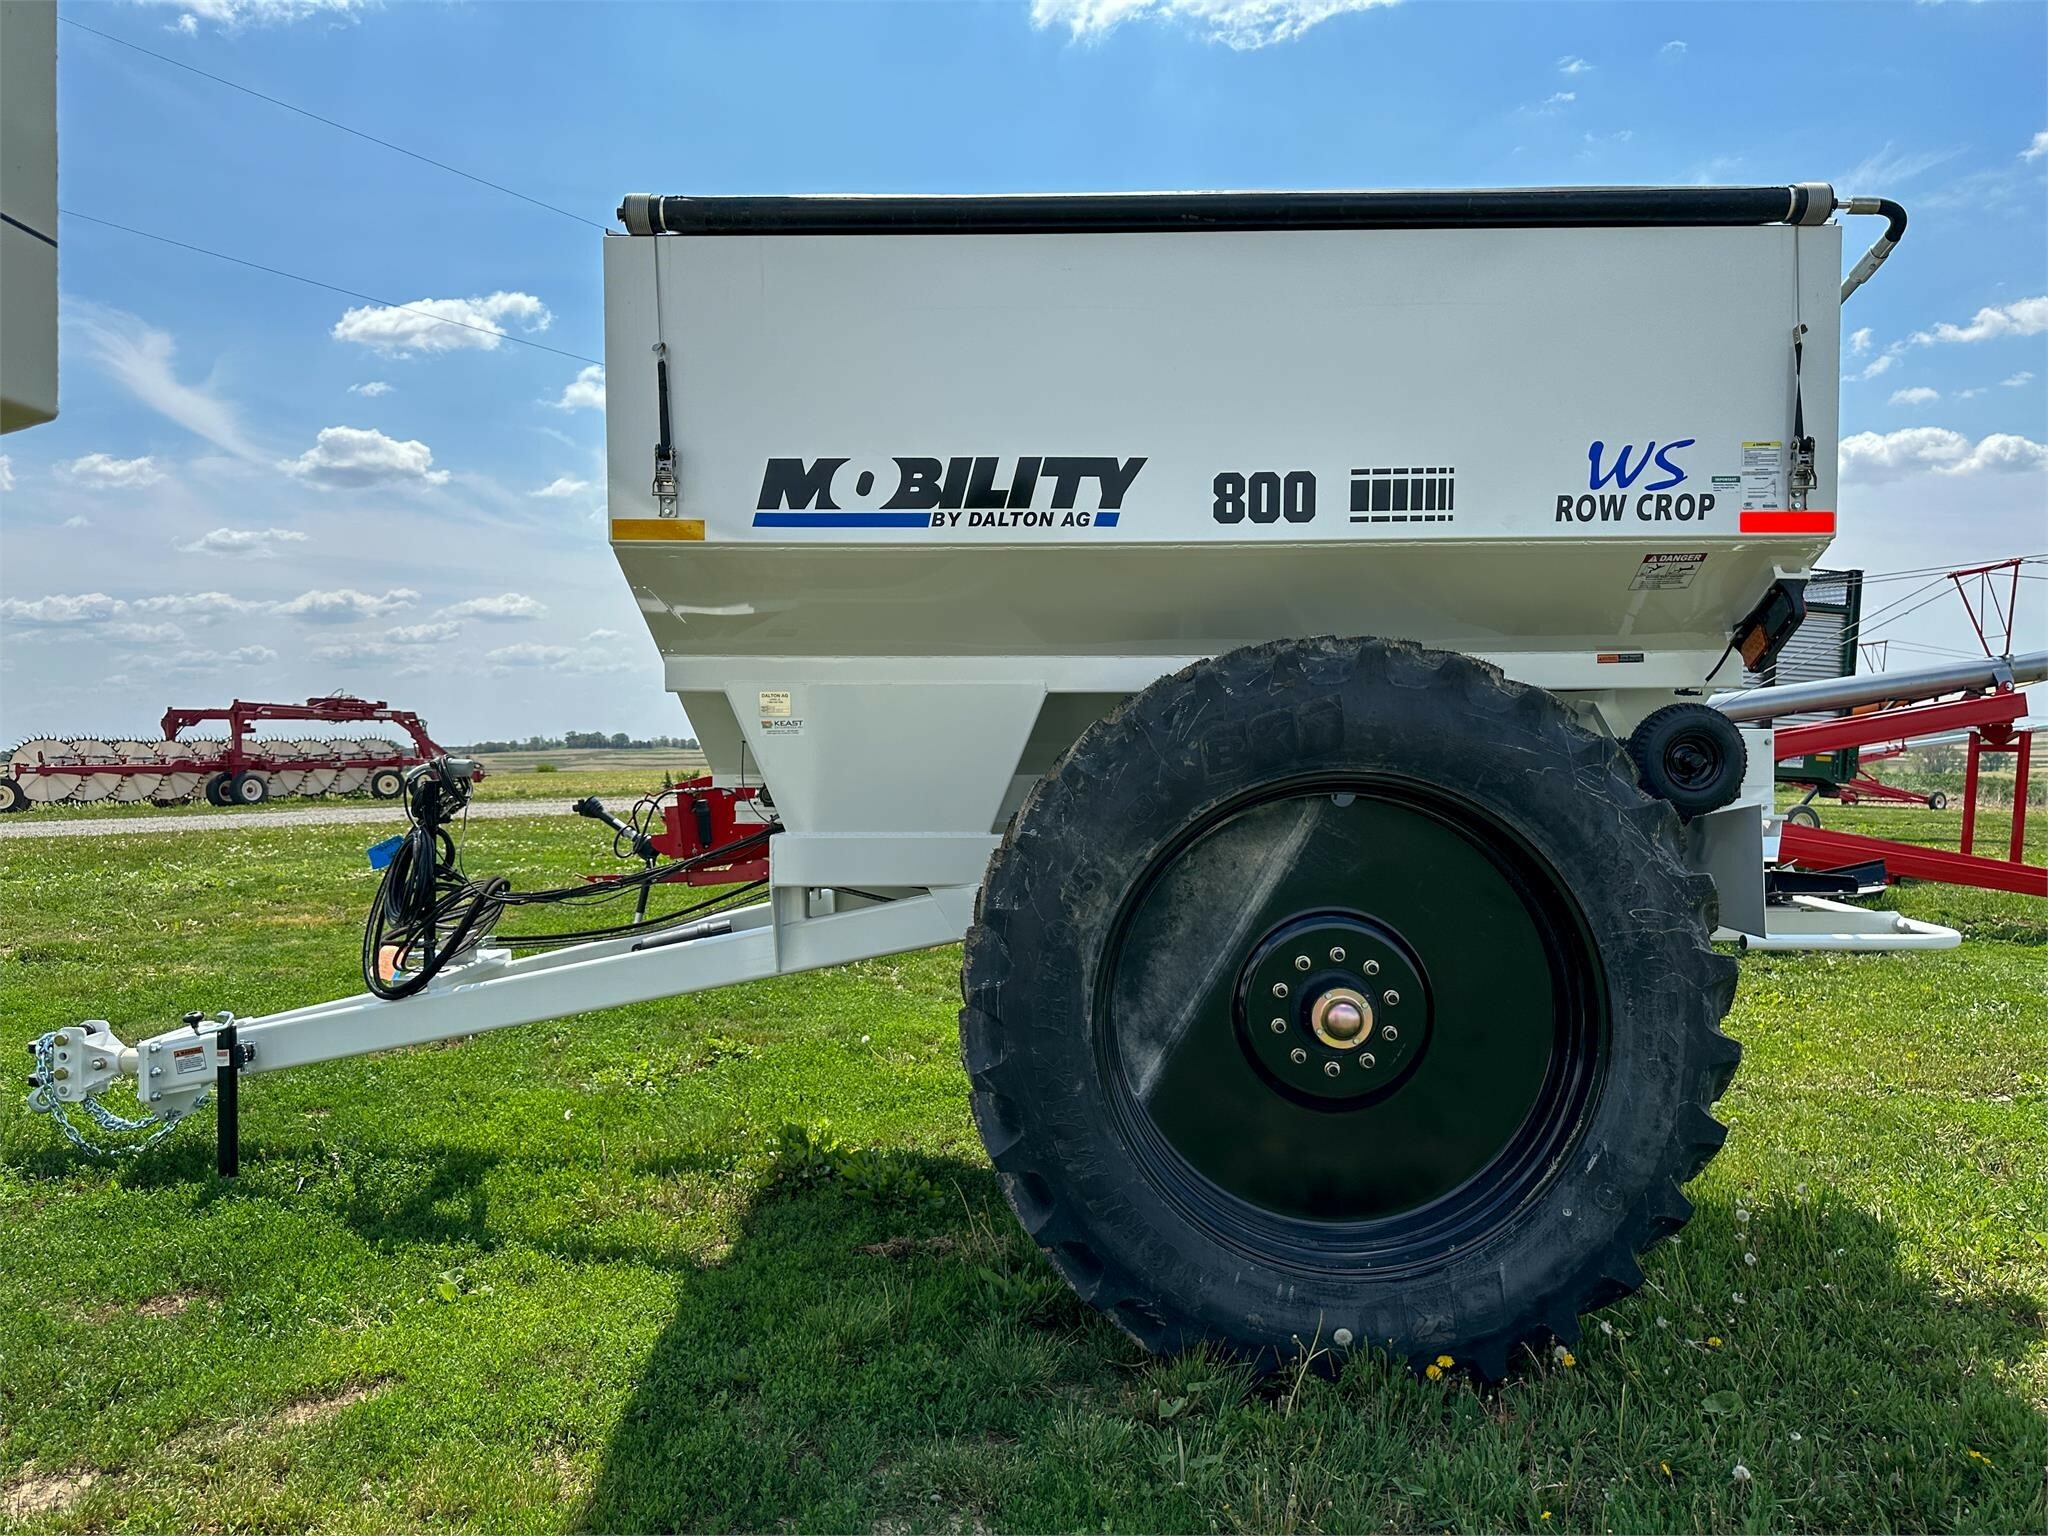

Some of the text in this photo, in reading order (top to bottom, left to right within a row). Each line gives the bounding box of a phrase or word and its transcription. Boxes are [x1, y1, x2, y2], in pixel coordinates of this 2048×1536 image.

[756, 456, 1148, 510] MOBILITY
[1588, 439, 1696, 491] WS
[1213, 470, 1317, 524] 800
[1555, 494, 1627, 523] ROW
[1636, 493, 1716, 521] CROP
[931, 511, 1090, 527] BY DALTON AG
[1659, 554, 1702, 562] DANGER
